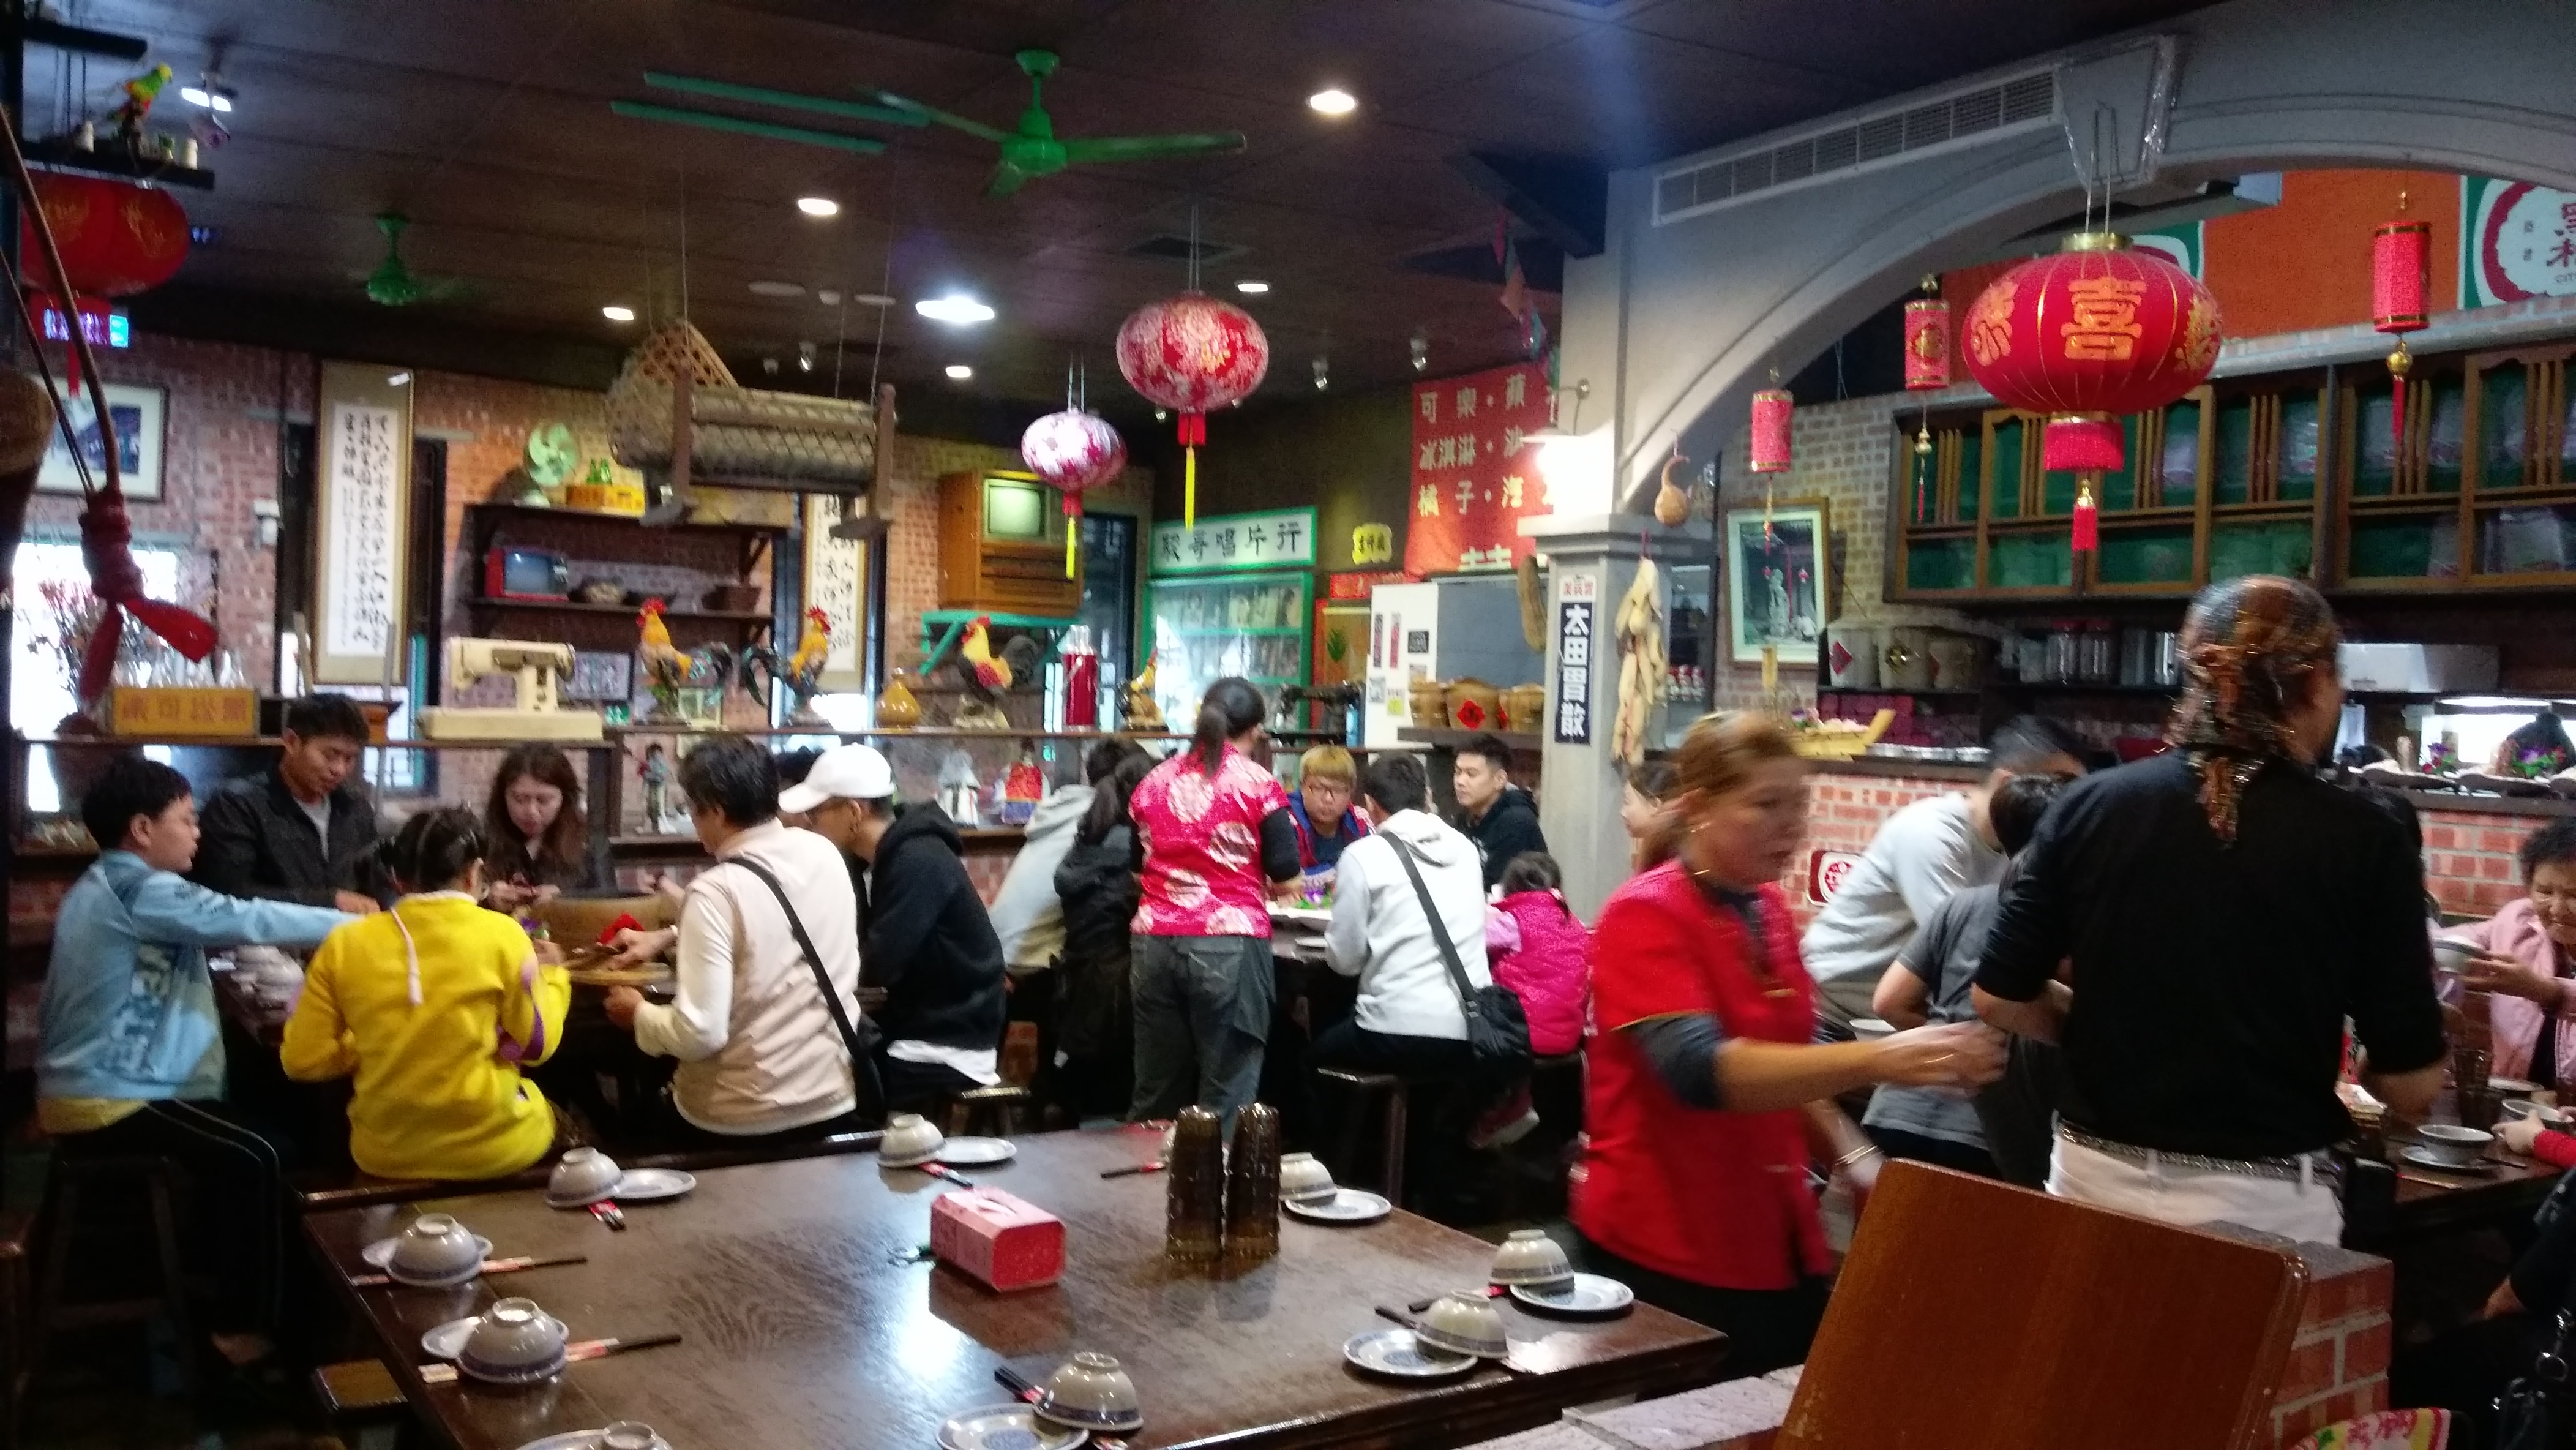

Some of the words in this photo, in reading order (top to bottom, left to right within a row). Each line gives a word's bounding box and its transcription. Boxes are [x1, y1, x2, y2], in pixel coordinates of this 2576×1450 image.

[2060, 276, 2147, 361] 喜
[1560, 604, 1590, 739] 太田胃散
